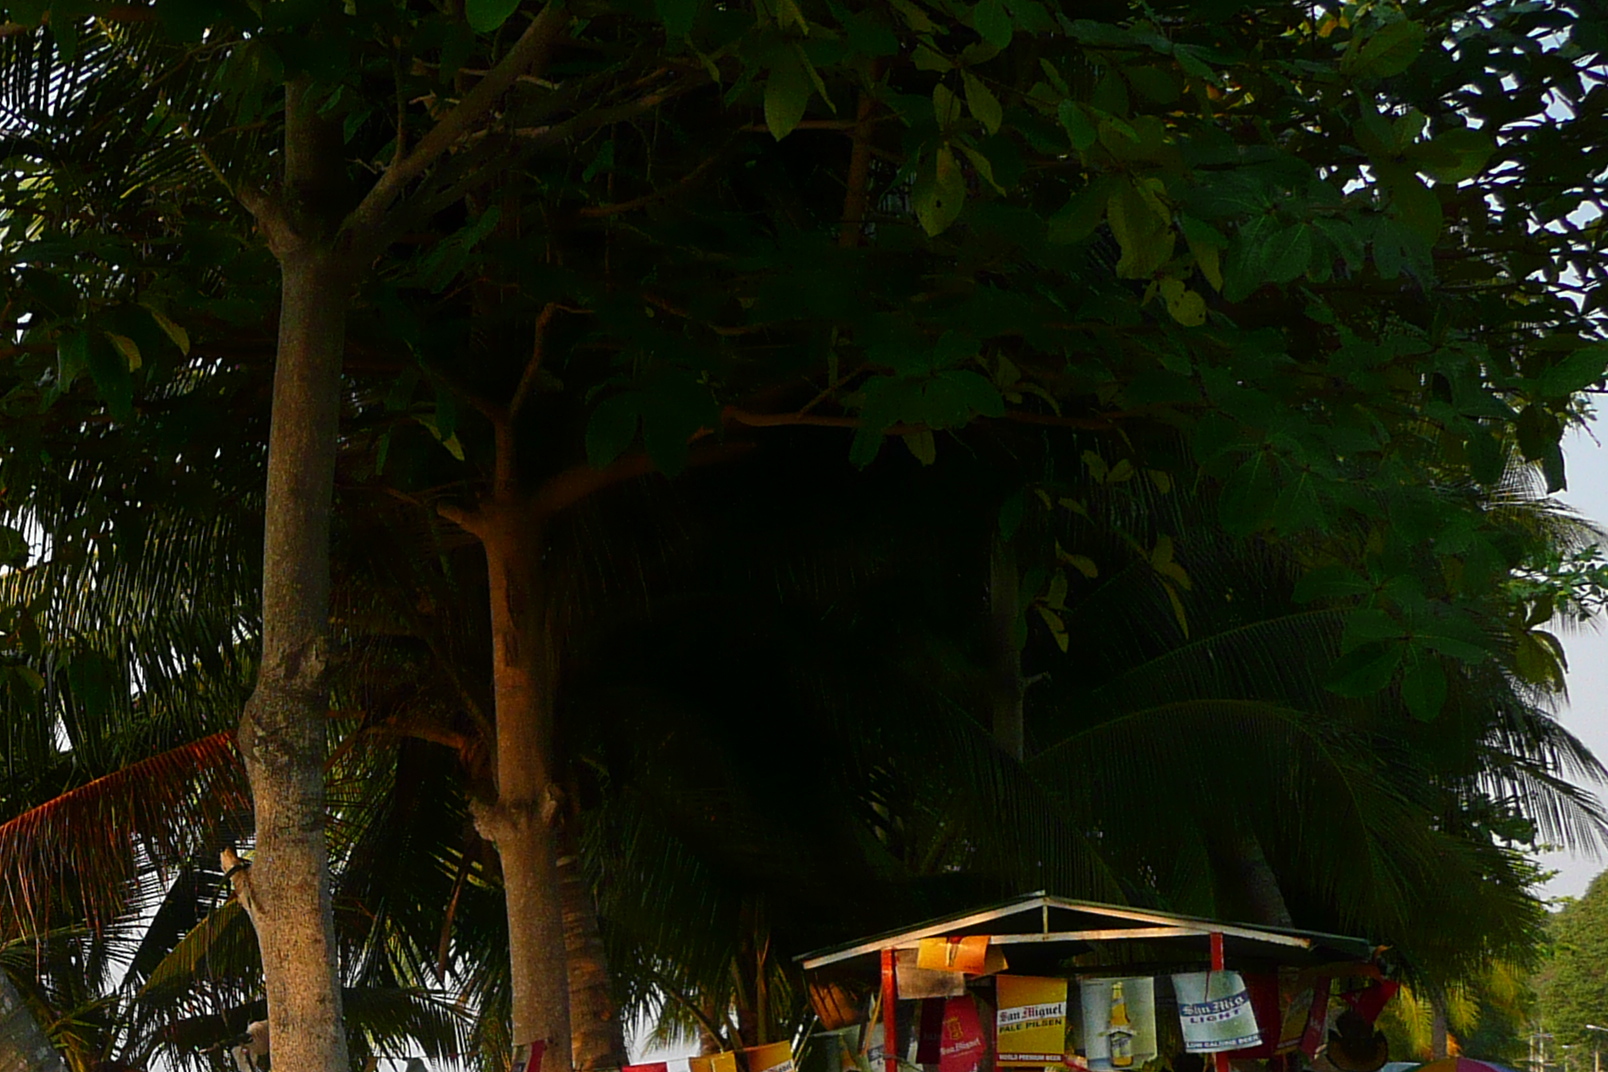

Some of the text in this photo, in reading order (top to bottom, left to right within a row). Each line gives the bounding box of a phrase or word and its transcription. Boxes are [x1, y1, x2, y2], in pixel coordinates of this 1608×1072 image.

[999, 1003, 1063, 1022] San Miguel
[1190, 1007, 1242, 1024] LIGHT
[999, 1019, 1062, 1033] PALE PILSEN
